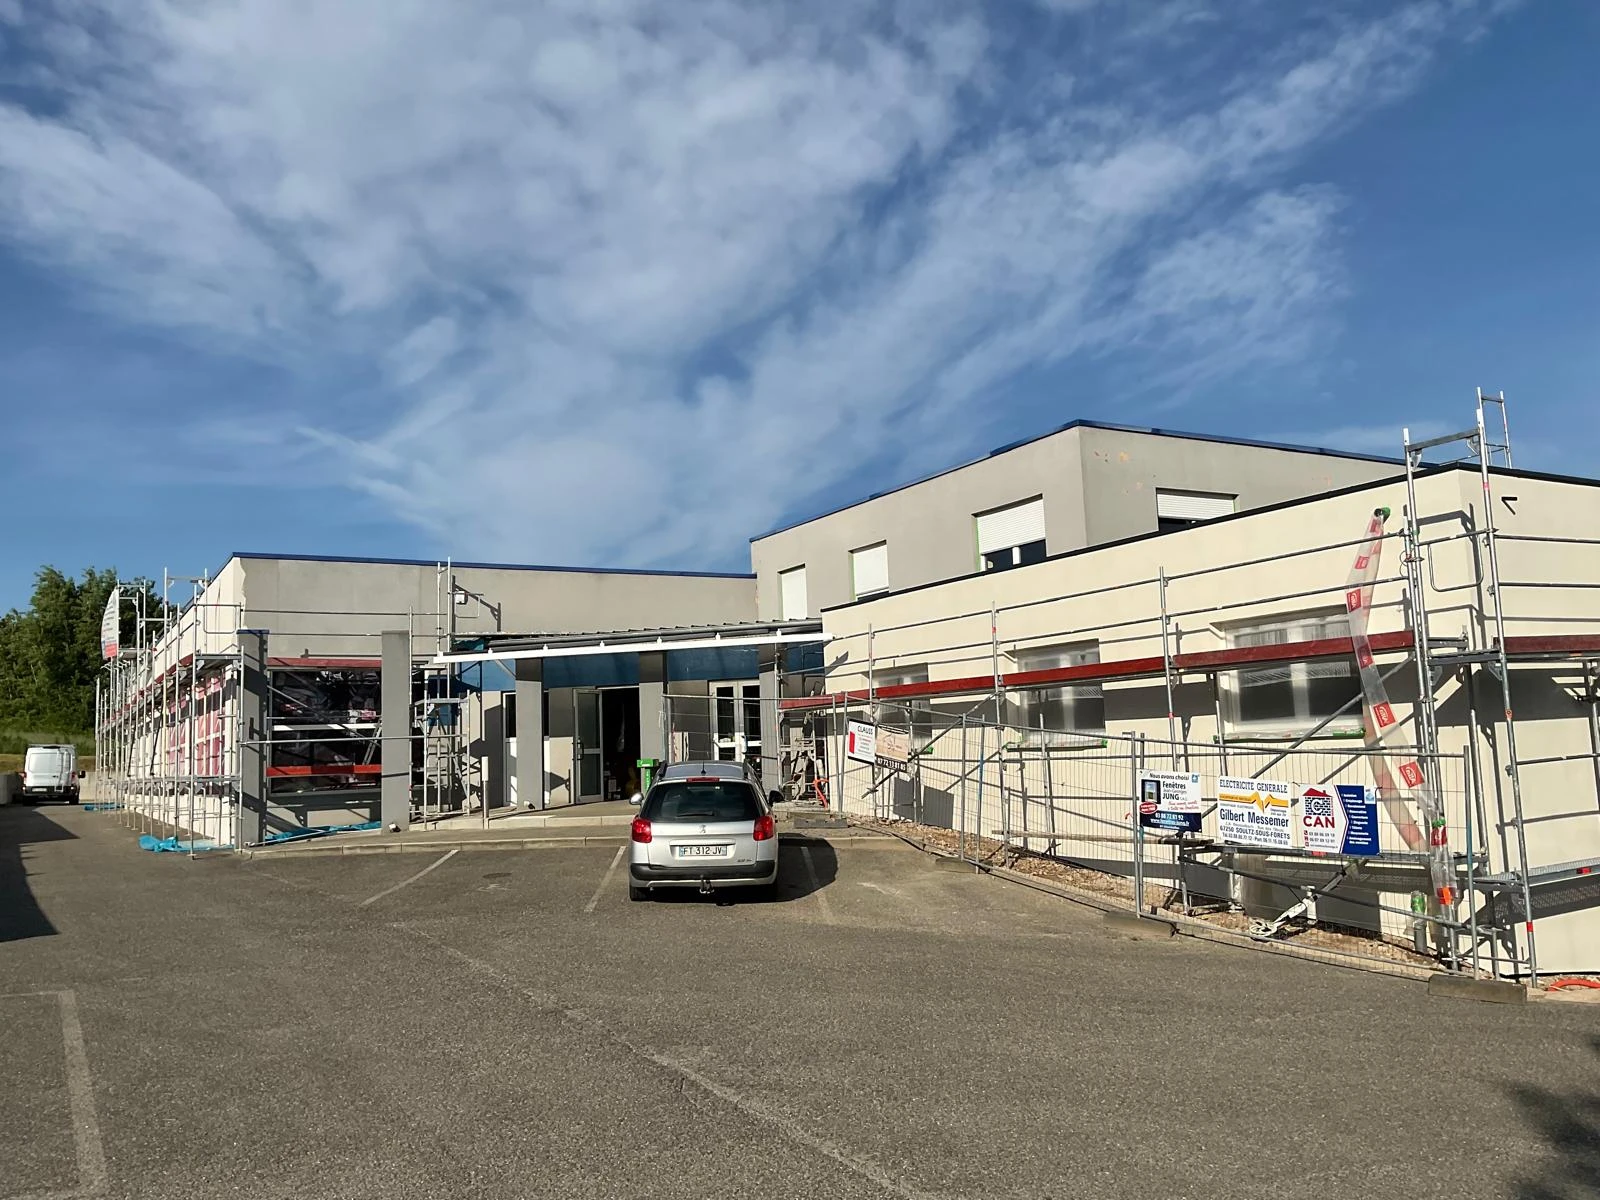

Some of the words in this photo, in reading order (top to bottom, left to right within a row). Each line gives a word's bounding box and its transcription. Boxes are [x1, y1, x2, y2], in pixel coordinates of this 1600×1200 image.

[1162, 781, 1186, 789] Fenêtres
[1219, 779, 1254, 790] ELECTRICITE
[1257, 783, 1288, 793] GENERALE
[1220, 809, 1244, 822] Gilbert
[1248, 812, 1288, 827] Messemer
[1303, 815, 1335, 829] CAN
[1219, 825, 1234, 833] 67250
